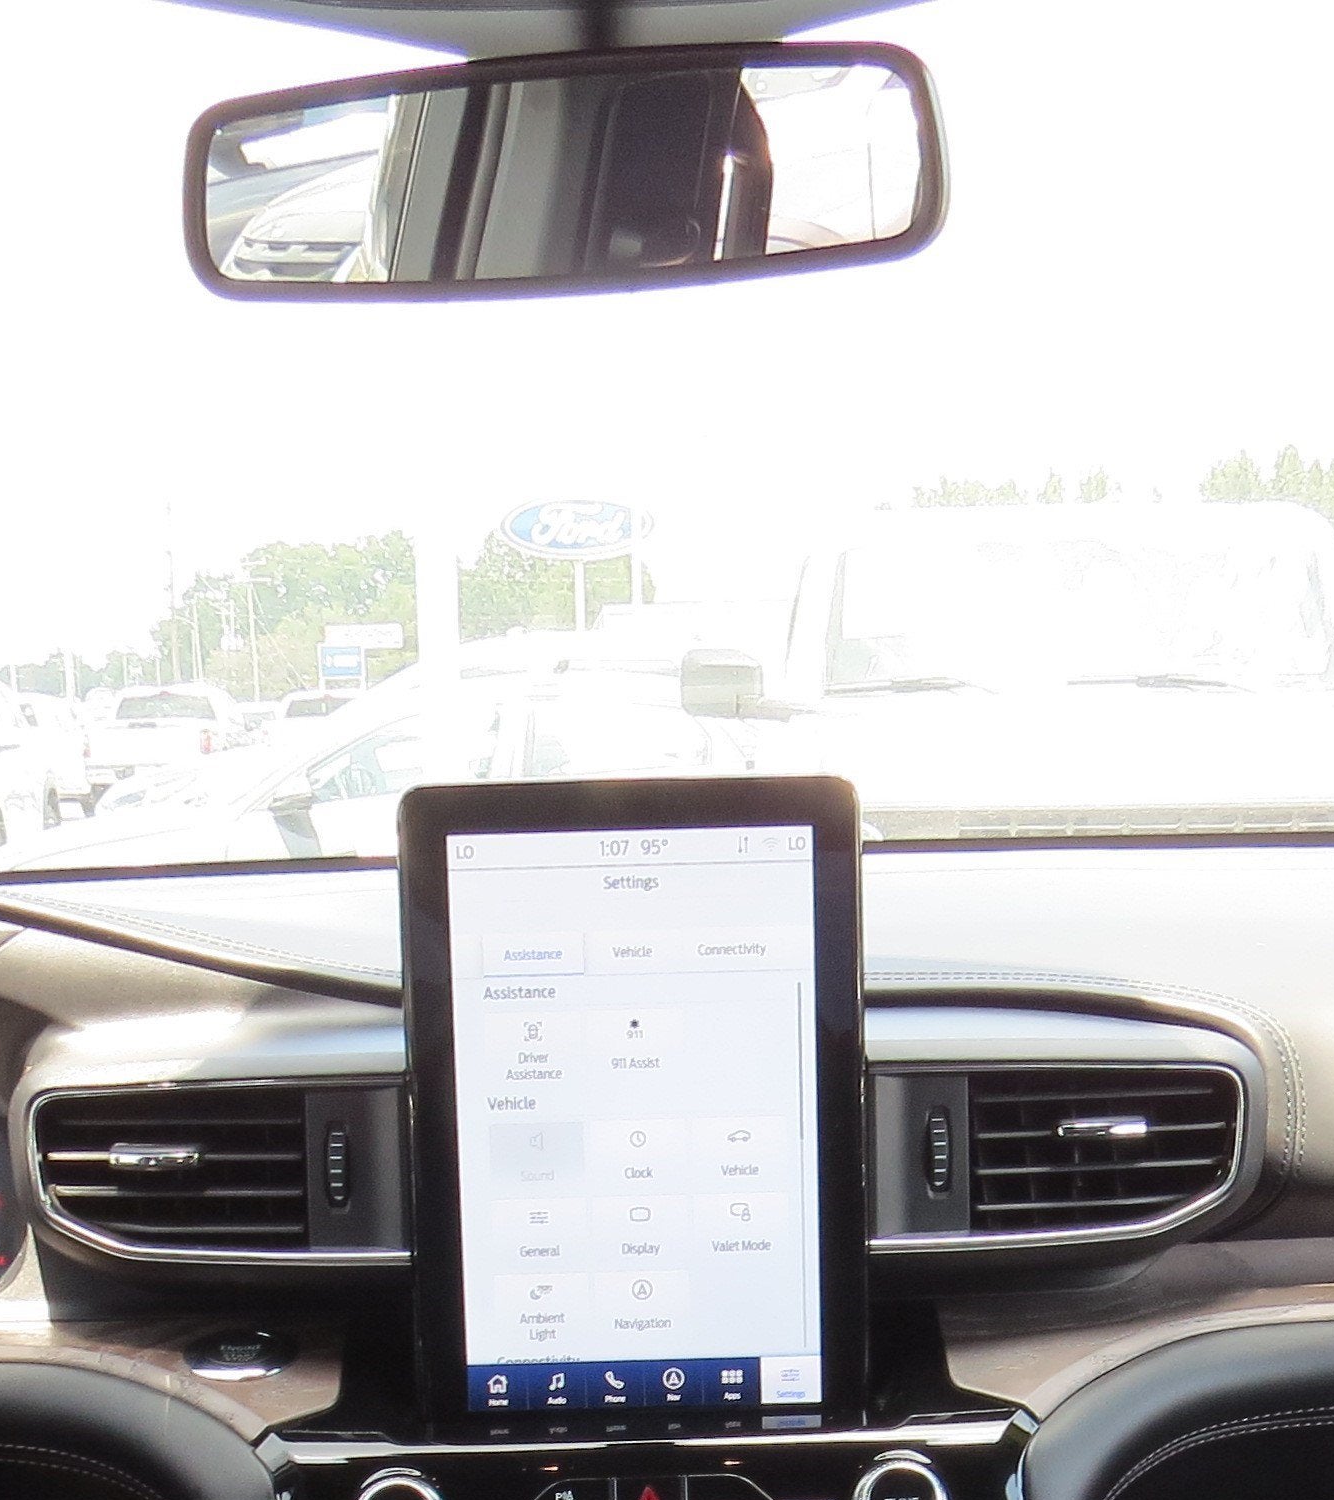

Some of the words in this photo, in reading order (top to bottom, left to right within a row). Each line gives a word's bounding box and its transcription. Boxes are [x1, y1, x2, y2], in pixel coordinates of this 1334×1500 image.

[531, 501, 627, 546] Ford
[600, 840, 629, 857] 1:07
[641, 839, 668, 855] 95°
[788, 836, 806, 851] LO
[456, 845, 474, 860] LO
[603, 875, 659, 890] Settings
[504, 948, 562, 961] Assistance
[612, 945, 652, 958] Vehicle
[697, 943, 766, 956] Connectivity
[484, 985, 555, 1000] Assistance
[626, 1029, 643, 1039] 911
[518, 1052, 549, 1064] Driver
[611, 1057, 627, 1069] 911
[629, 1056, 660, 1069] Assist
[506, 1067, 562, 1080] Assistance
[487, 1096, 536, 1111] Vehicle
[521, 1169, 555, 1182] Sound
[625, 1167, 653, 1180] Clock
[721, 1163, 759, 1176] Vehicle
[520, 1245, 560, 1257] General
[622, 1242, 660, 1256] Display
[712, 1239, 739, 1252] Valet
[742, 1238, 771, 1251] Mode
[520, 1312, 564, 1324] Ambient
[614, 1316, 671, 1330] Navigation
[530, 1328, 556, 1341] Light
[547, 1396, 566, 1405] Audio
[605, 1395, 626, 1403] Phone
[724, 1391, 741, 1401] Apps
[776, 1390, 805, 1400] Settings
